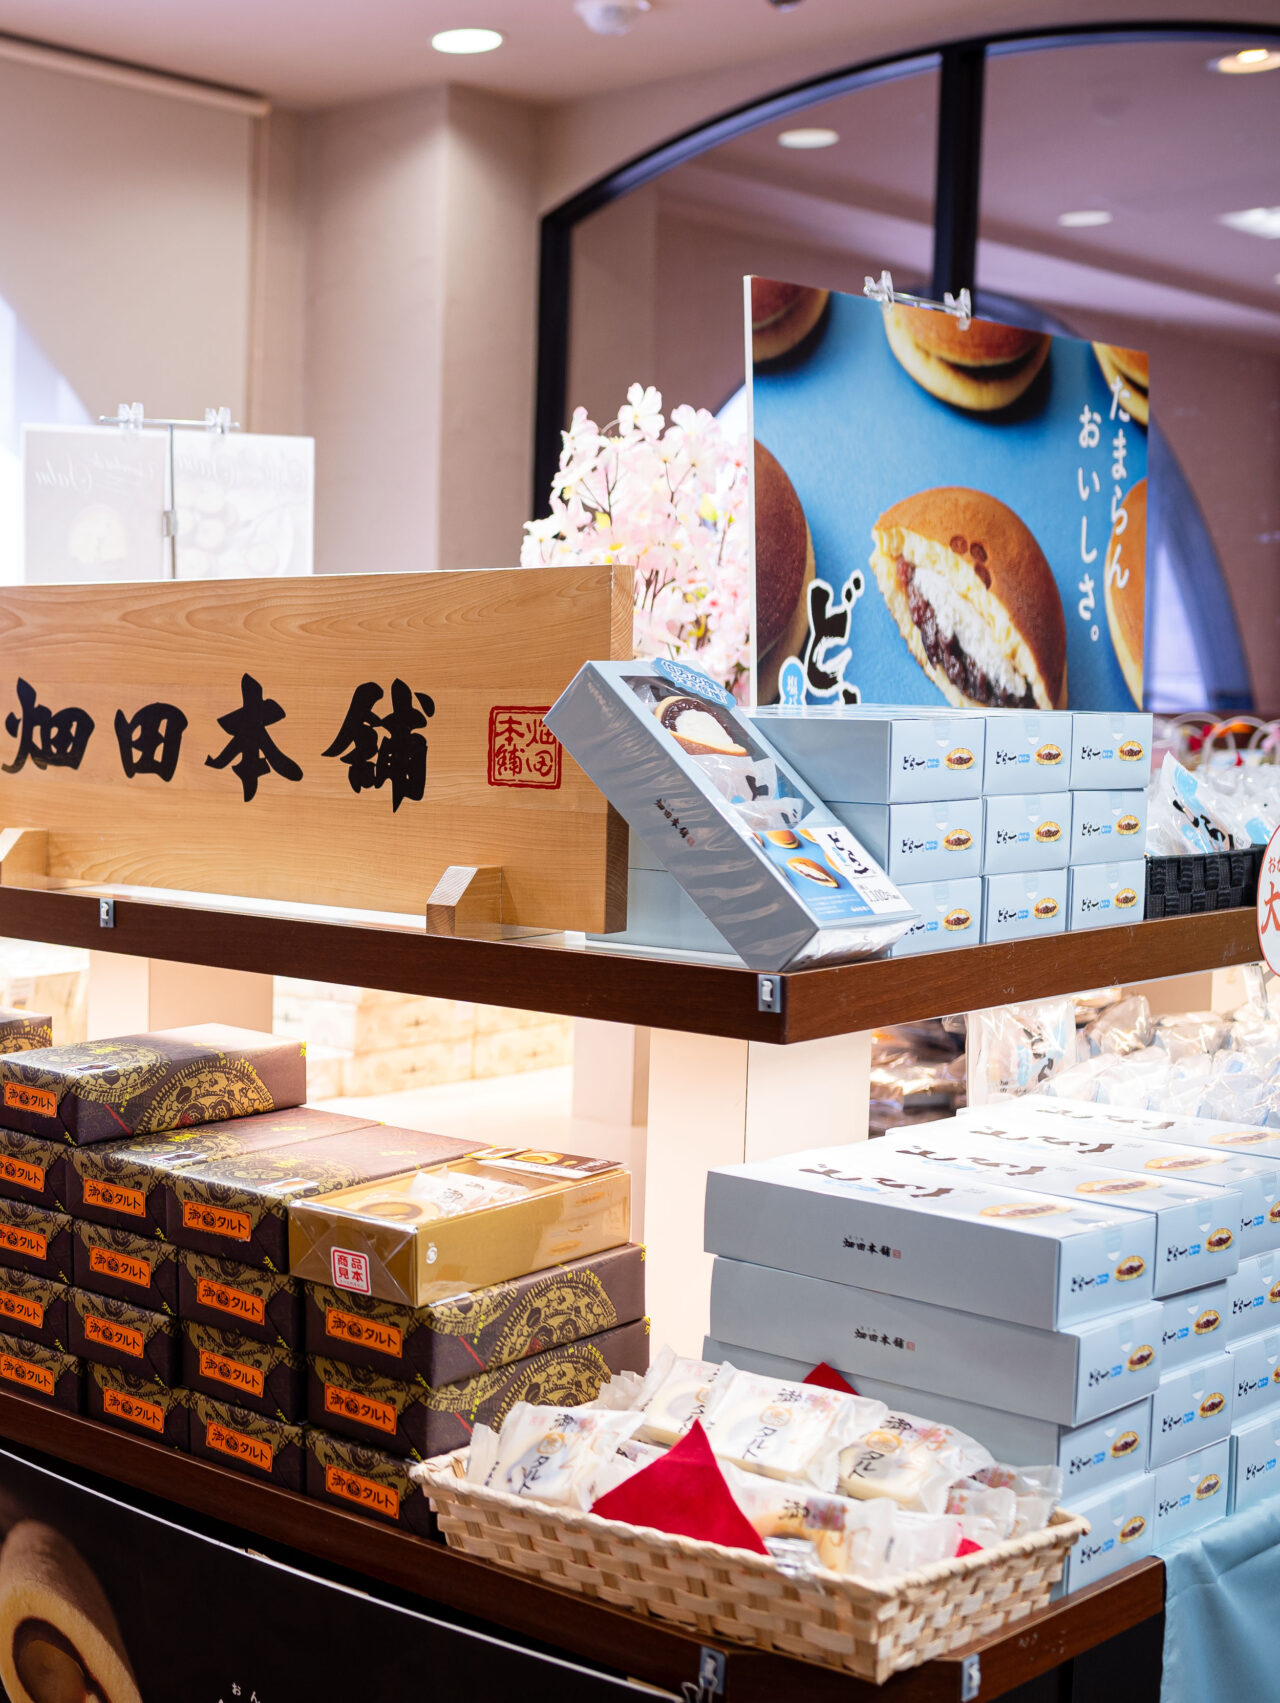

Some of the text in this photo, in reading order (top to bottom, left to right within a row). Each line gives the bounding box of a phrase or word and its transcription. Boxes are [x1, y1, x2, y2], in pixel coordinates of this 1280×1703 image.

[1077, 404, 1102, 642] おいしさ。
[1107, 375, 1131, 591] たまらん
[1, 672, 436, 812] 畑田本舗
[337, 1254, 363, 1270] 商品
[338, 1267, 365, 1283] 見本
